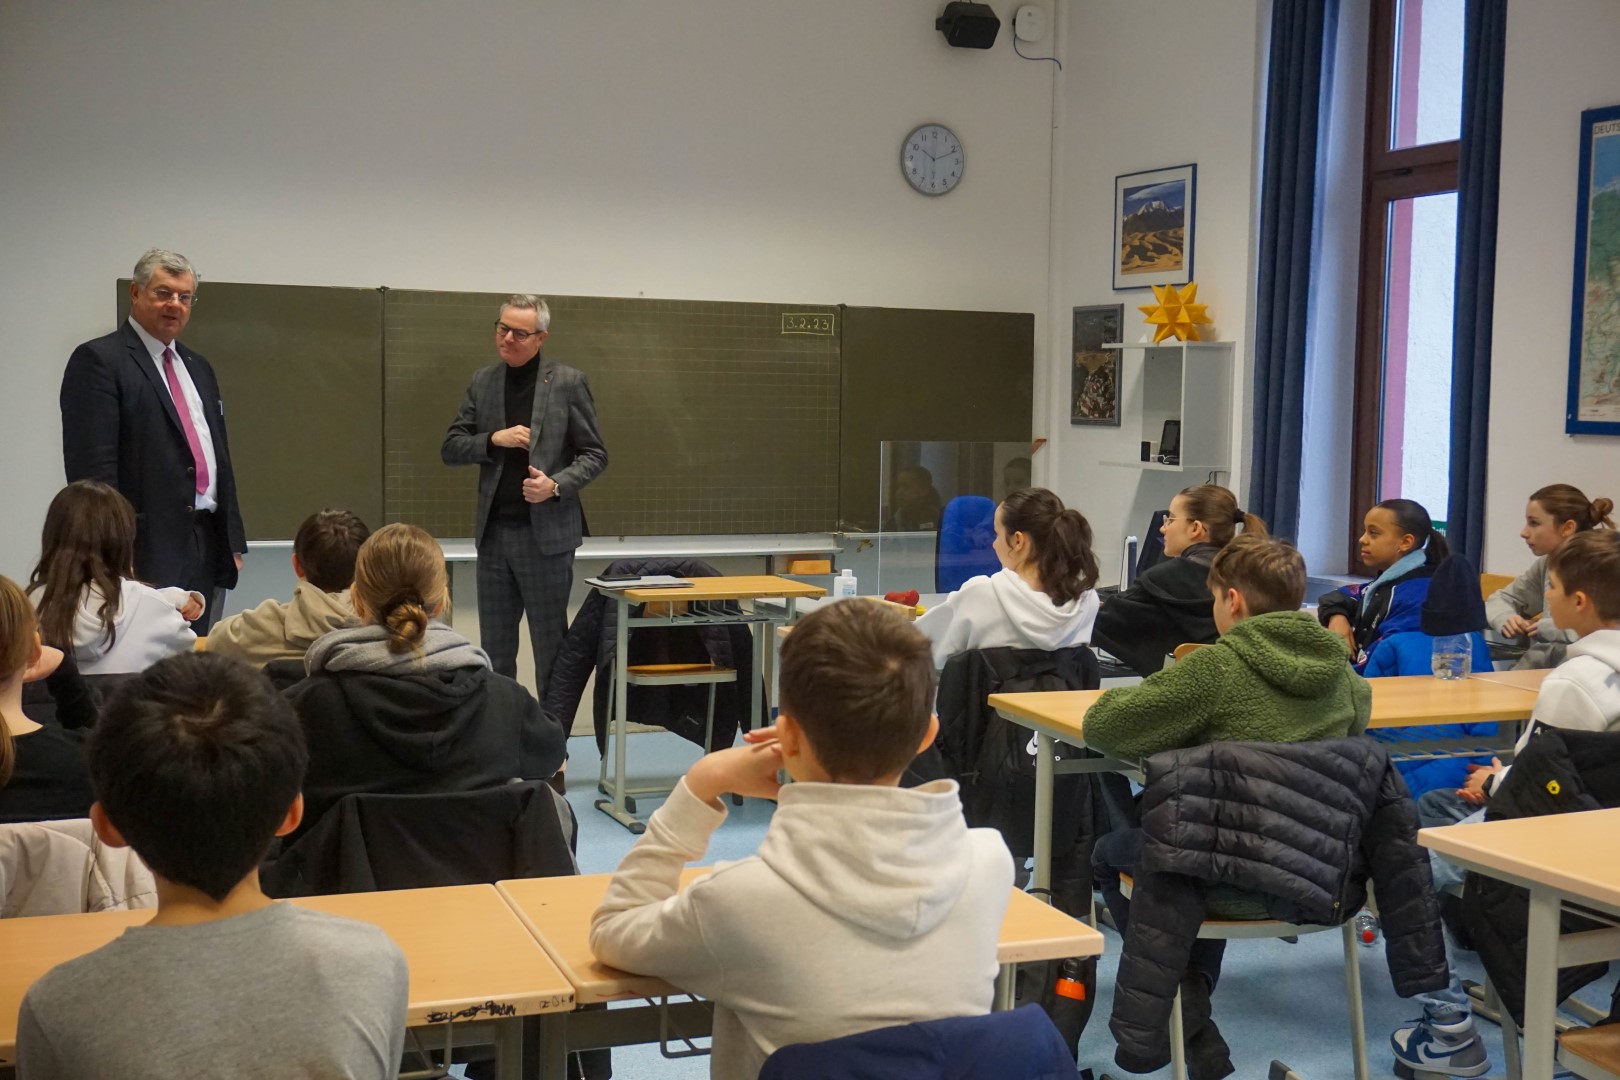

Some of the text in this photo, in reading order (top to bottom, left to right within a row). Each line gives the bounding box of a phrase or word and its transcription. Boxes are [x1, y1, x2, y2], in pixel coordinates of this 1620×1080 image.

[921, 134, 927, 142] 11
[931, 131, 938, 139] 12
[912, 143, 920, 151] 10
[786, 316, 829, 330] 3.2.23
